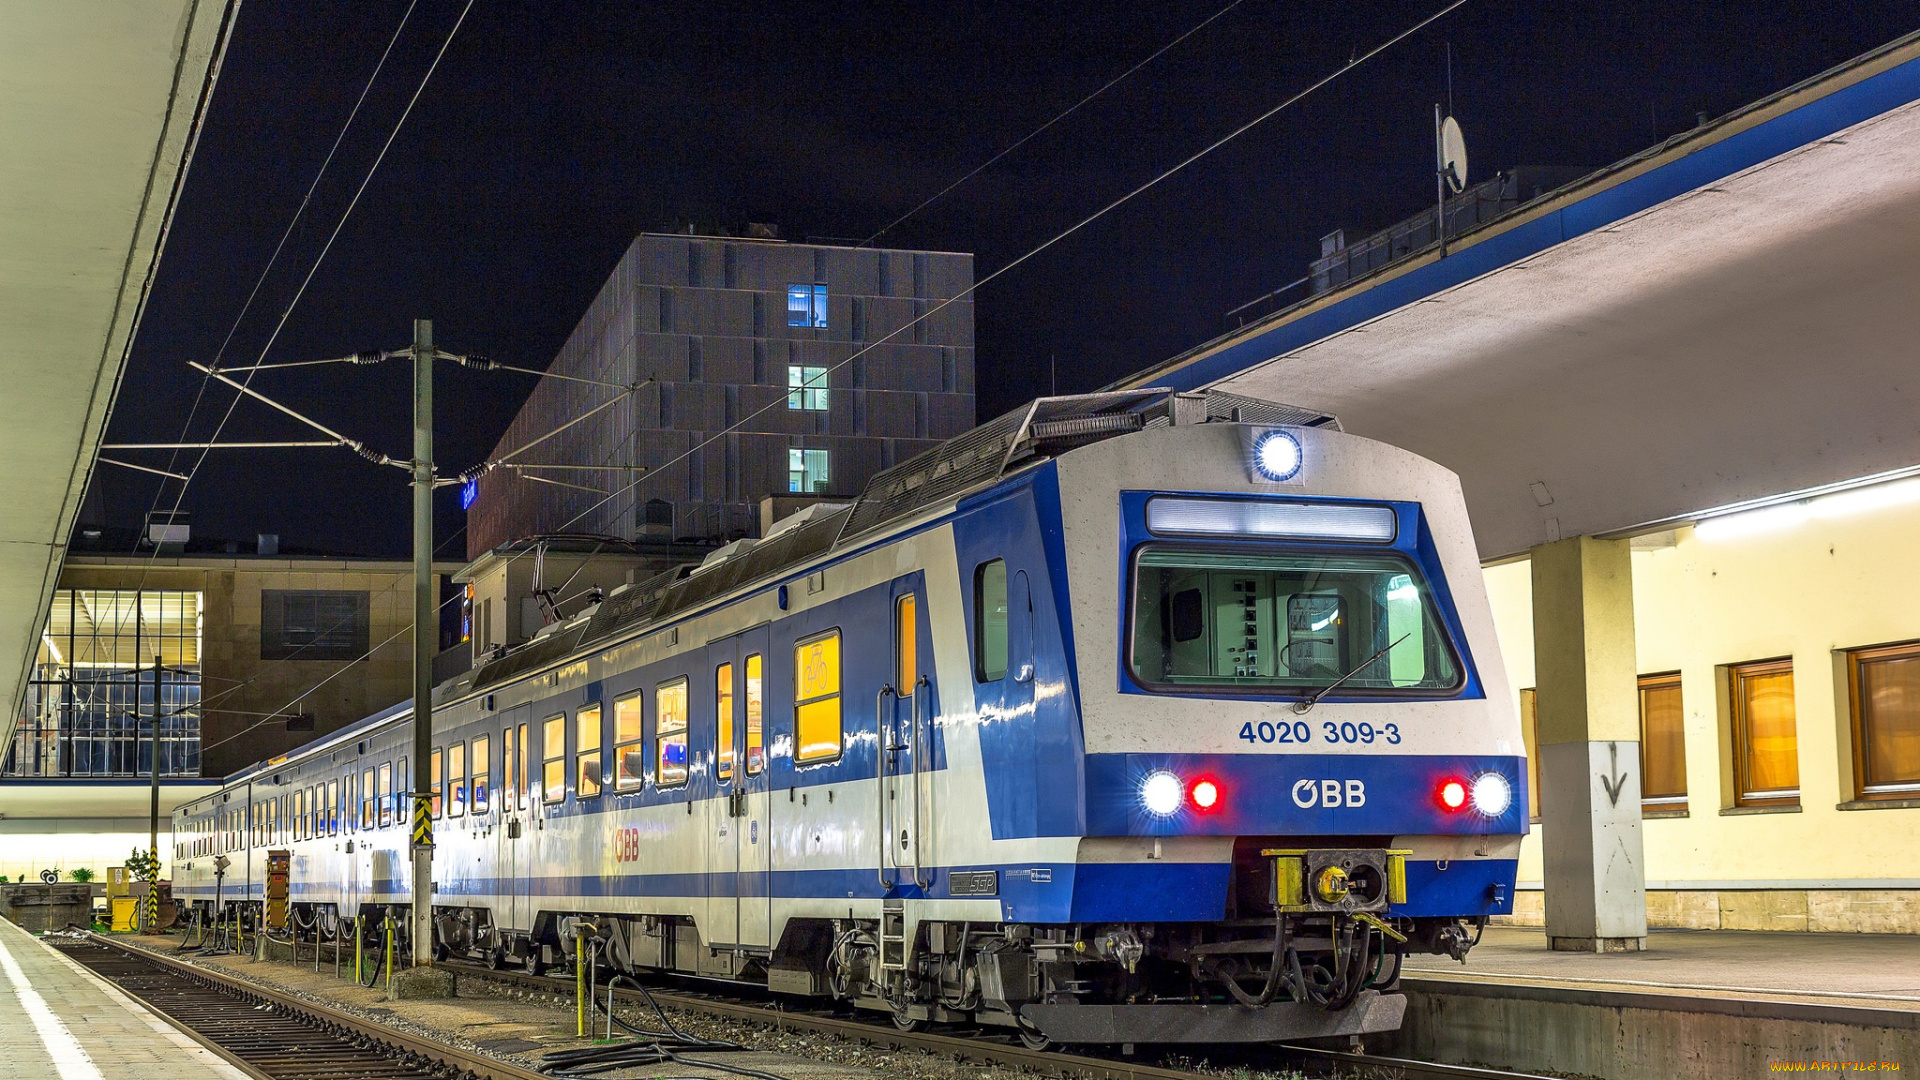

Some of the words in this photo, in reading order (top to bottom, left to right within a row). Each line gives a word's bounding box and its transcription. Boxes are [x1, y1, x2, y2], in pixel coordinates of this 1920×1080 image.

[1239, 721, 1311, 744] 4020
[1324, 721, 1402, 745] 309-3
[1291, 778, 1366, 809] ÖBB
[615, 828, 639, 863] ÖBB
[969, 874, 994, 892] SGP
